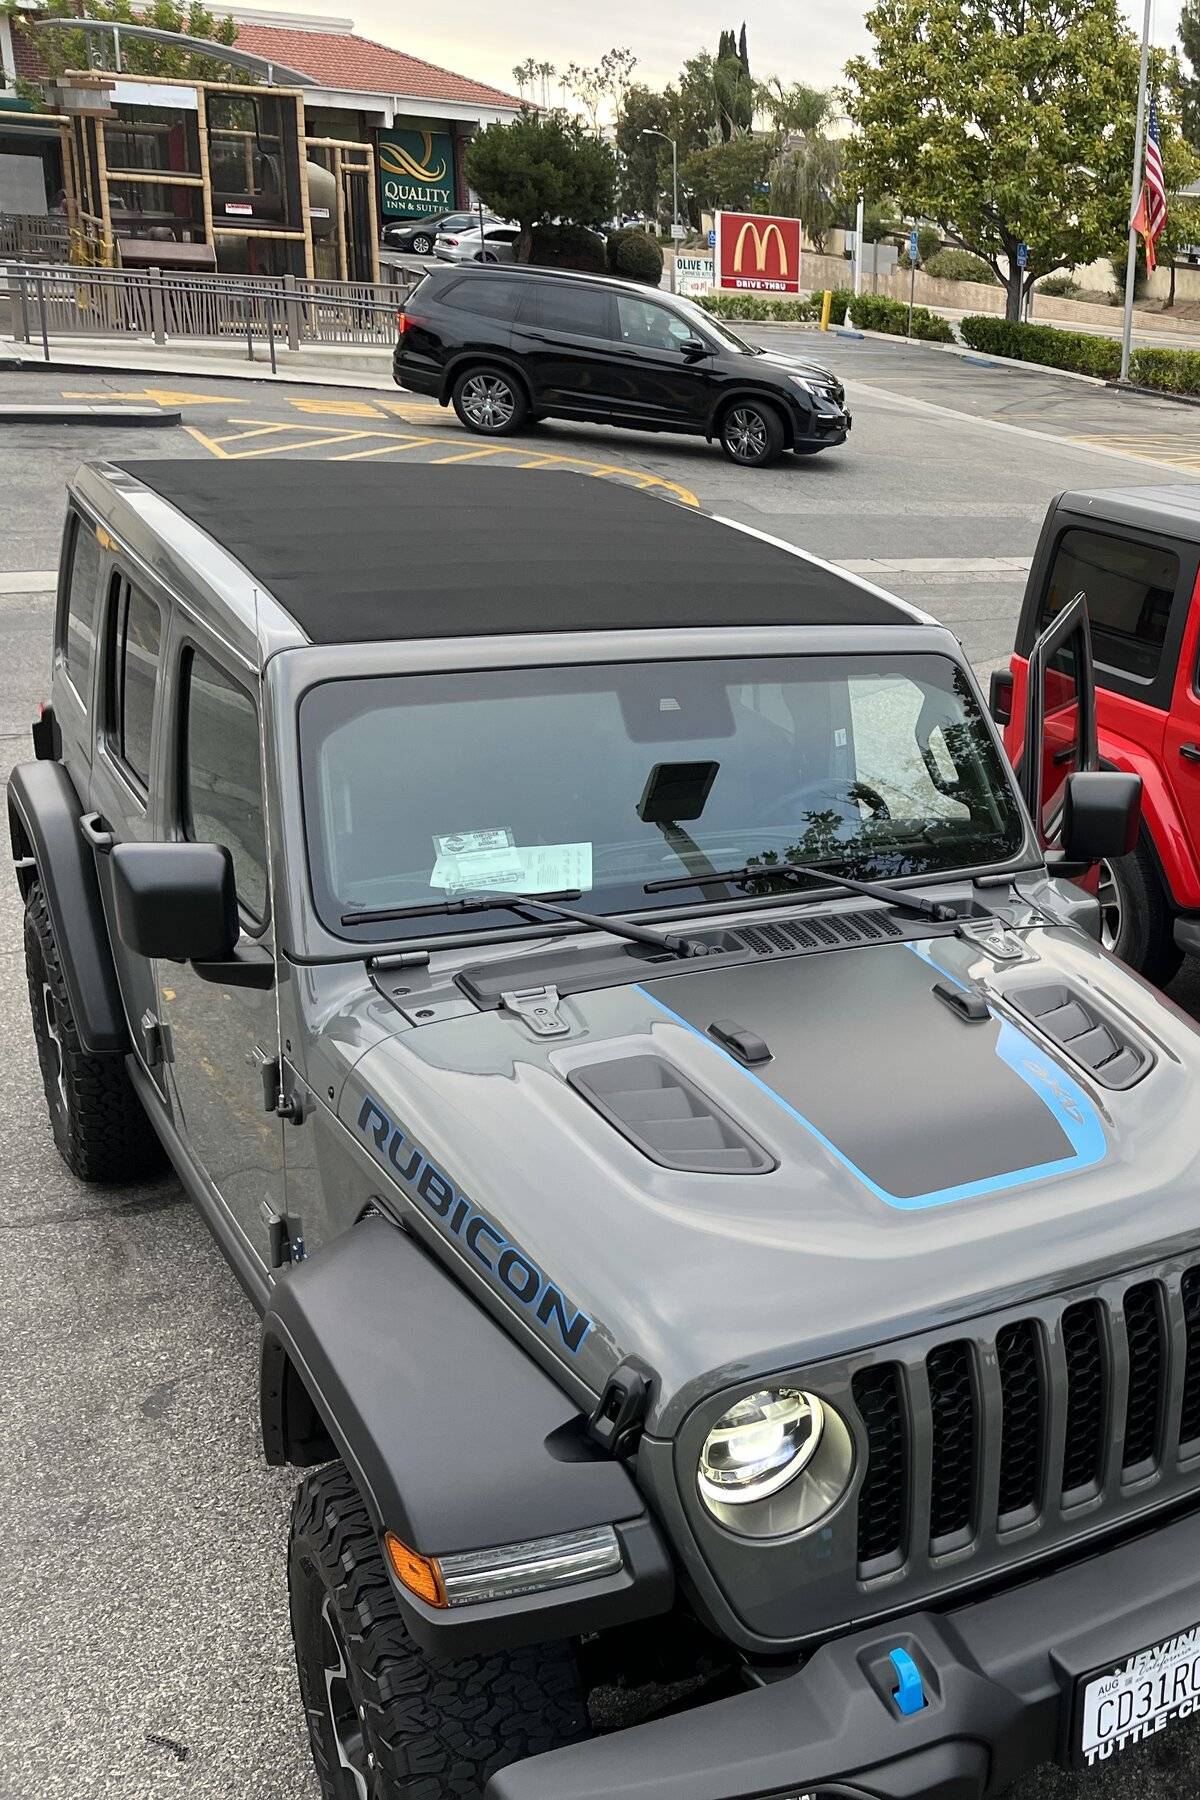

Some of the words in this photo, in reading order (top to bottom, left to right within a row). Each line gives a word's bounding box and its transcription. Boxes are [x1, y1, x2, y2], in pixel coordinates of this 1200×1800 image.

[385, 181, 450, 203] QUALITY
[387, 200, 406, 209] INN
[416, 204, 449, 212] SUITES
[677, 259, 701, 270] OLIVE
[356, 1095, 595, 1355] RUBICON
[1097, 1679, 1119, 1696] AUG
